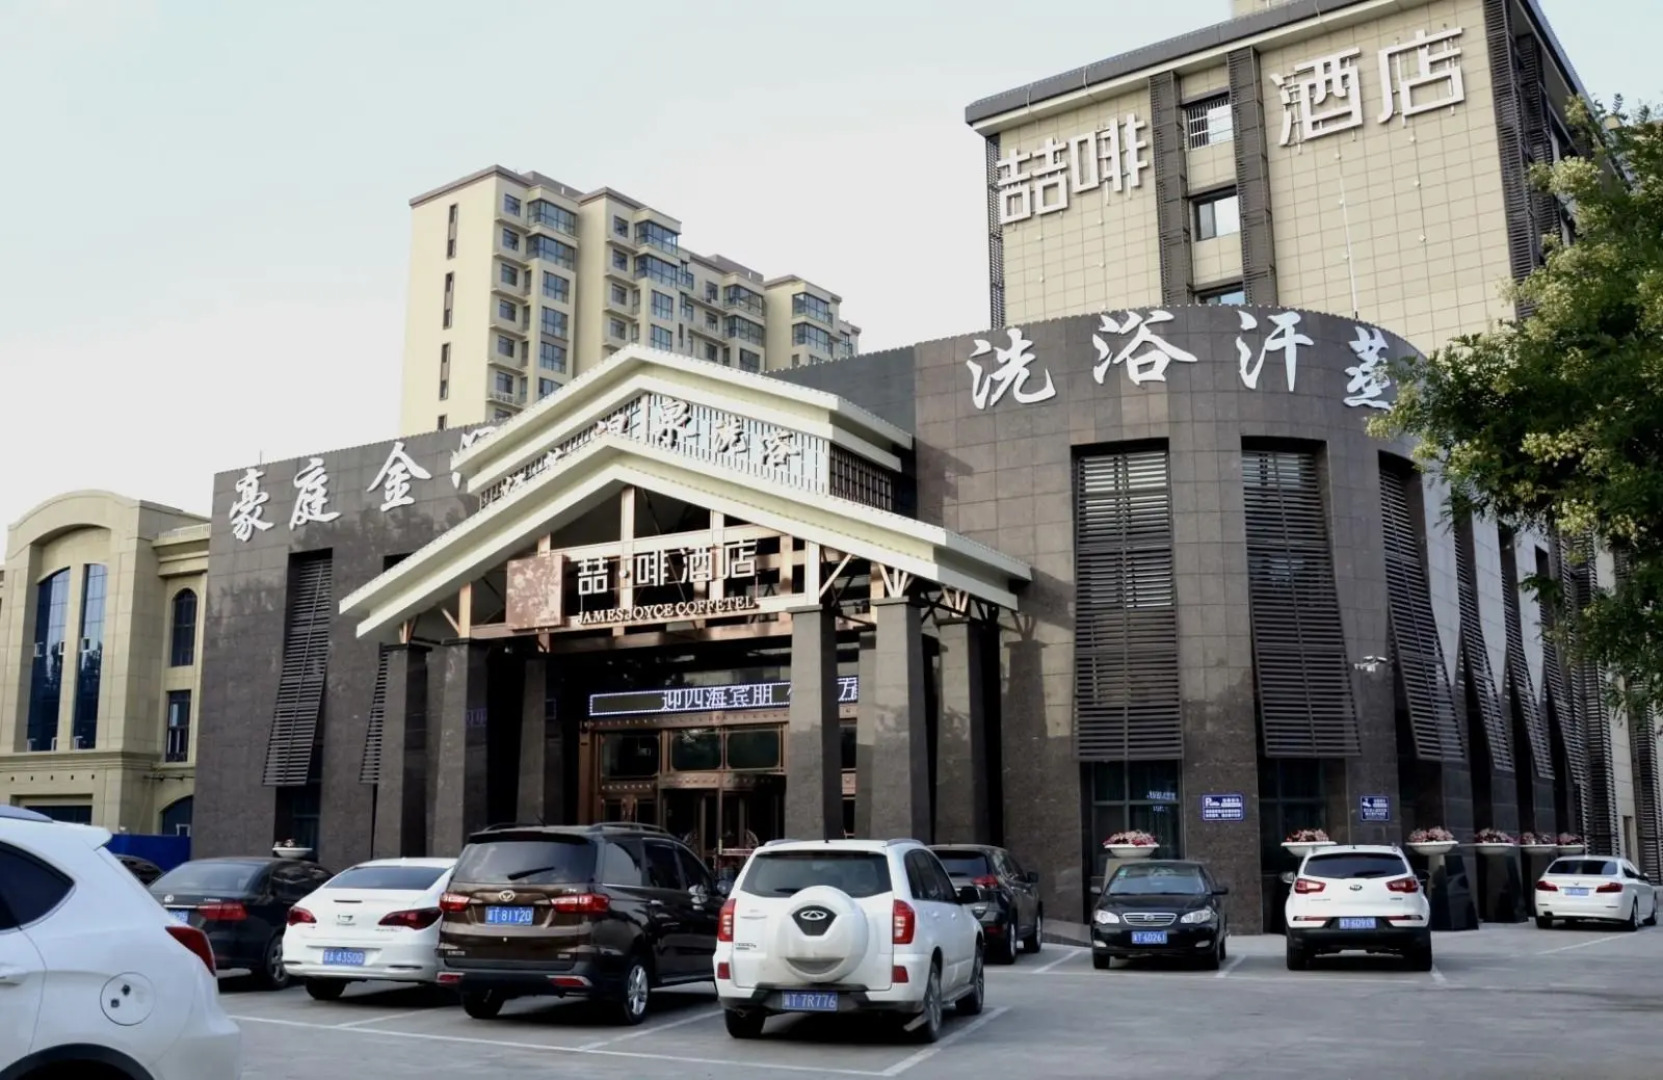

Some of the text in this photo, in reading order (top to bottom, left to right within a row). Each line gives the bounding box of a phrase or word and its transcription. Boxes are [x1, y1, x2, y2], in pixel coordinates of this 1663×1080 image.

[965, 308, 1397, 410] 洗浴汗蒸
[578, 608, 624, 625] JAMES
[624, 603, 674, 621] JOYCE
[661, 683, 774, 712] 迎四海宾朋
